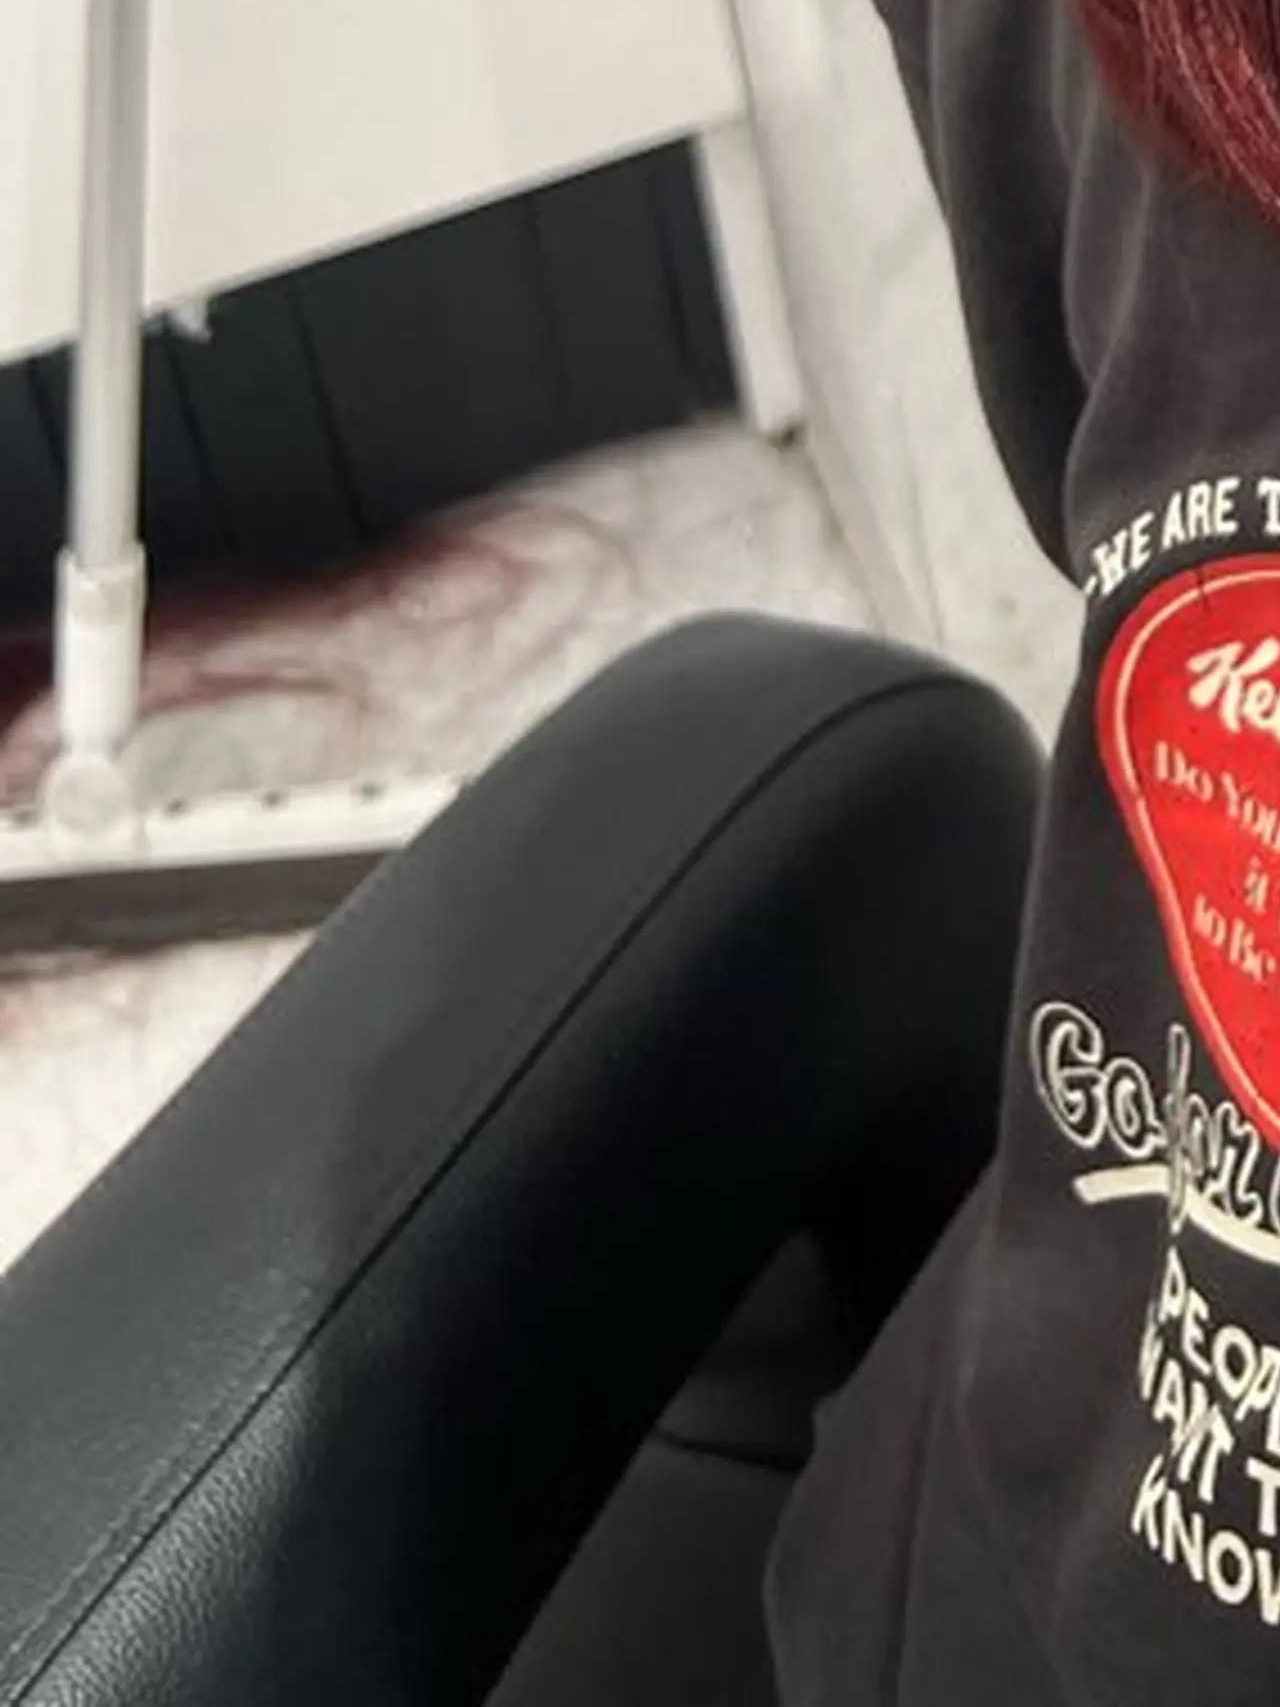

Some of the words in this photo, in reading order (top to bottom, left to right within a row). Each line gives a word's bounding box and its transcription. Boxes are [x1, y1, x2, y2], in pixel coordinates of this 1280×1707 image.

[1162, 478, 1240, 550] ARE
[1155, 742, 1214, 802] Do
[1229, 918, 1277, 982] Be
[1031, 1003, 1166, 1157] Go
